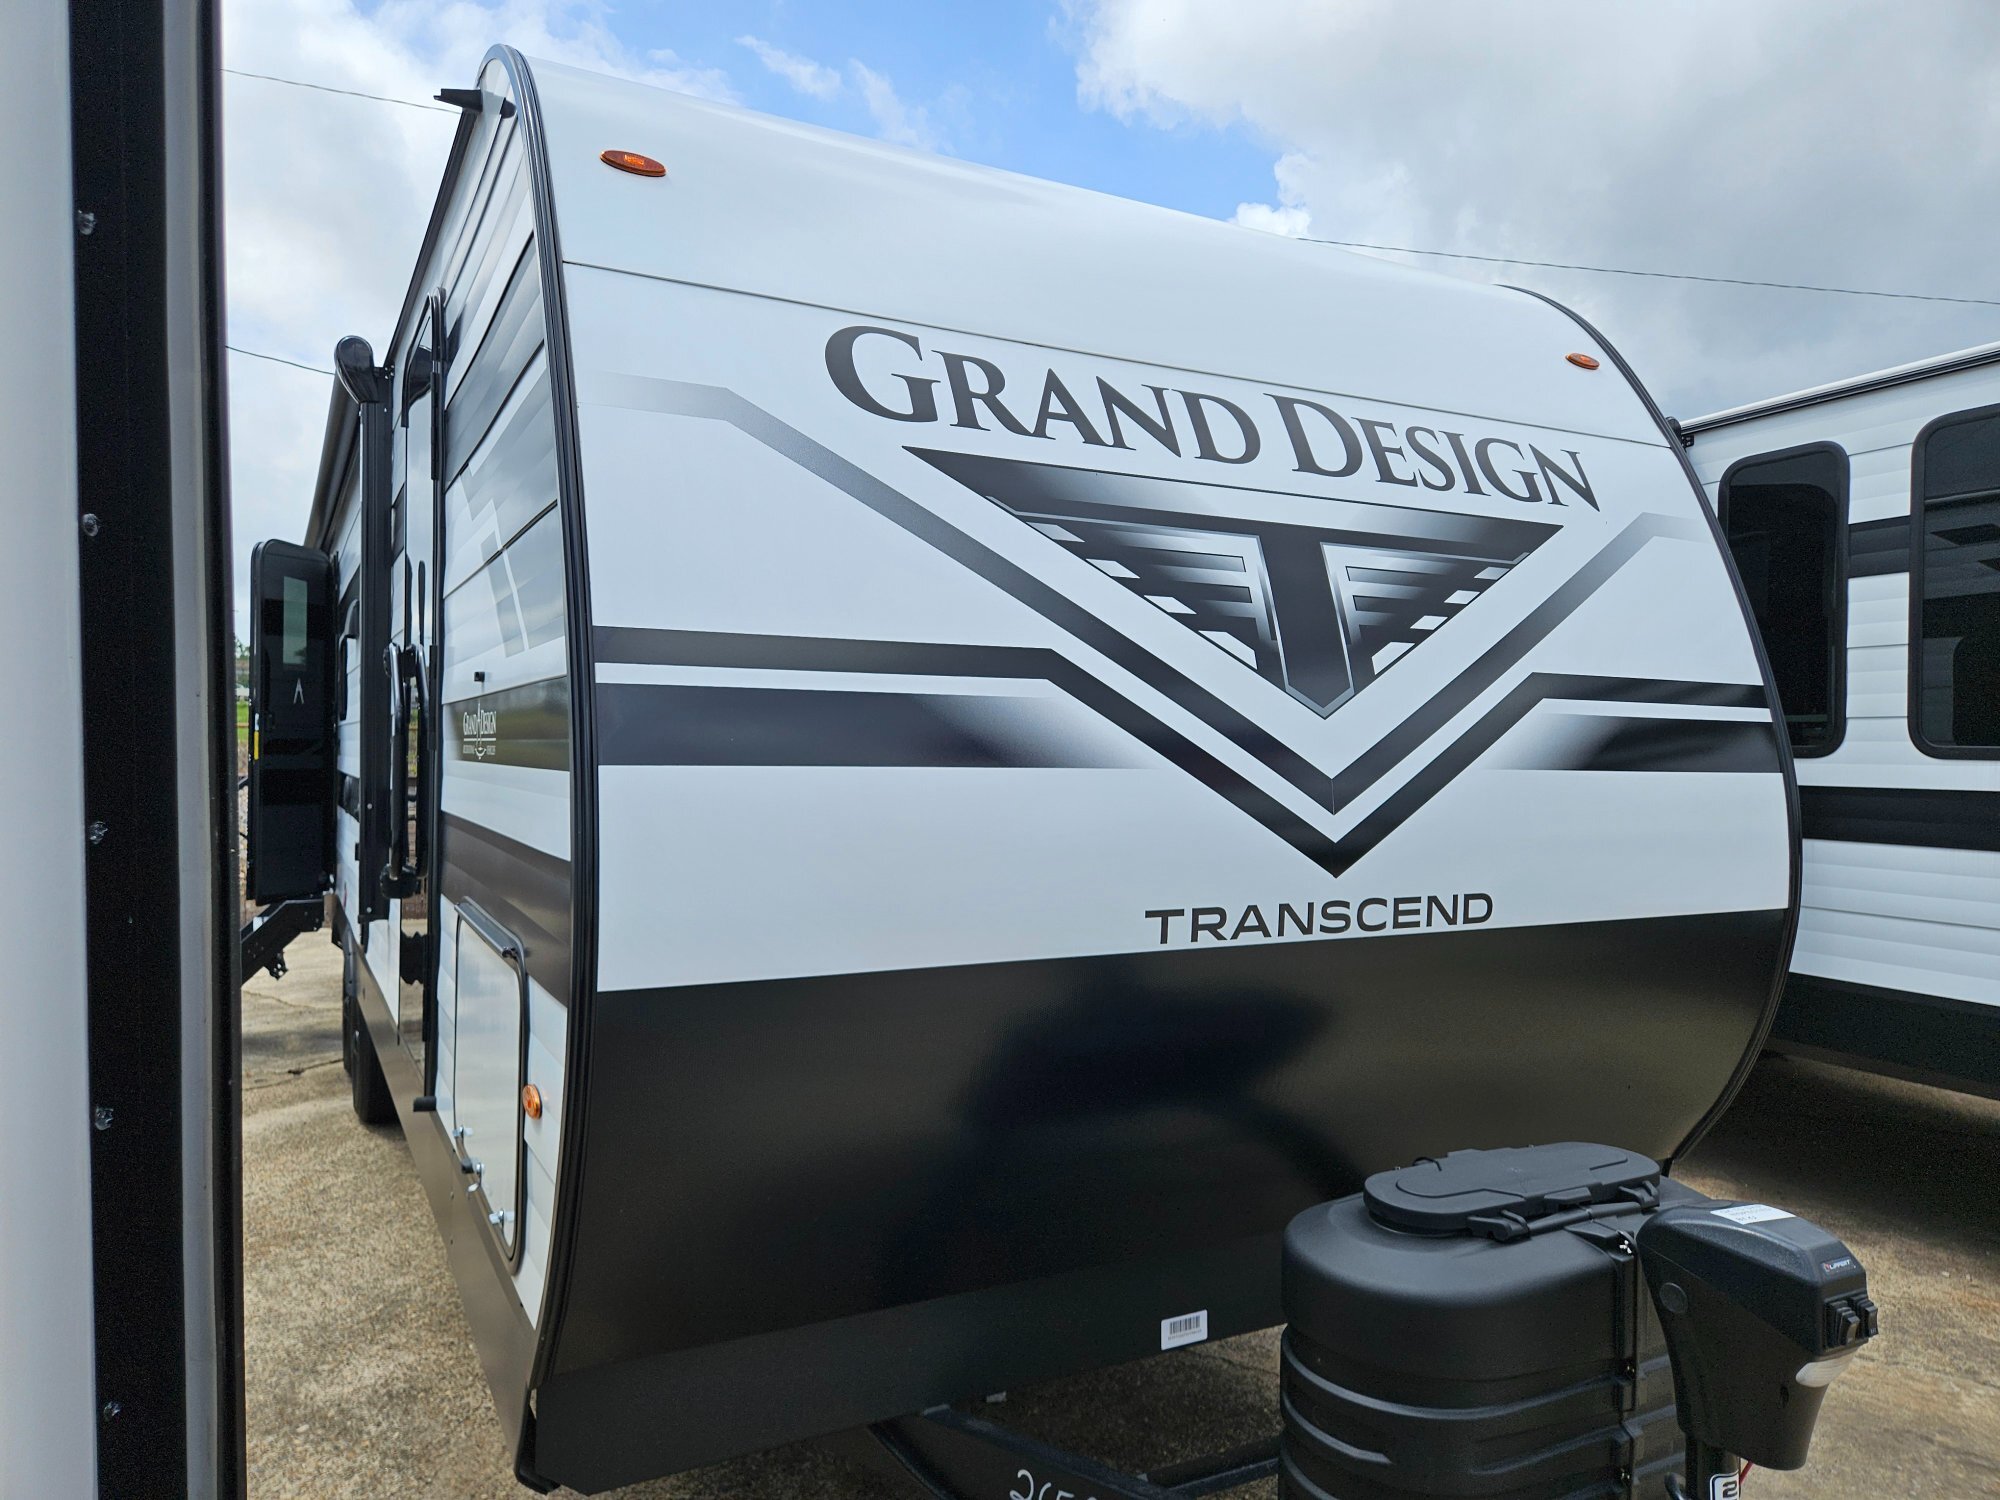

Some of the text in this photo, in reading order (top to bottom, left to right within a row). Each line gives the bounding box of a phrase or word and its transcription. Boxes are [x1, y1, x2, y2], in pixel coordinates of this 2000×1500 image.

[825, 325, 1601, 512] GRAND DESIGN
[1145, 892, 1493, 945] TRANSCEND
